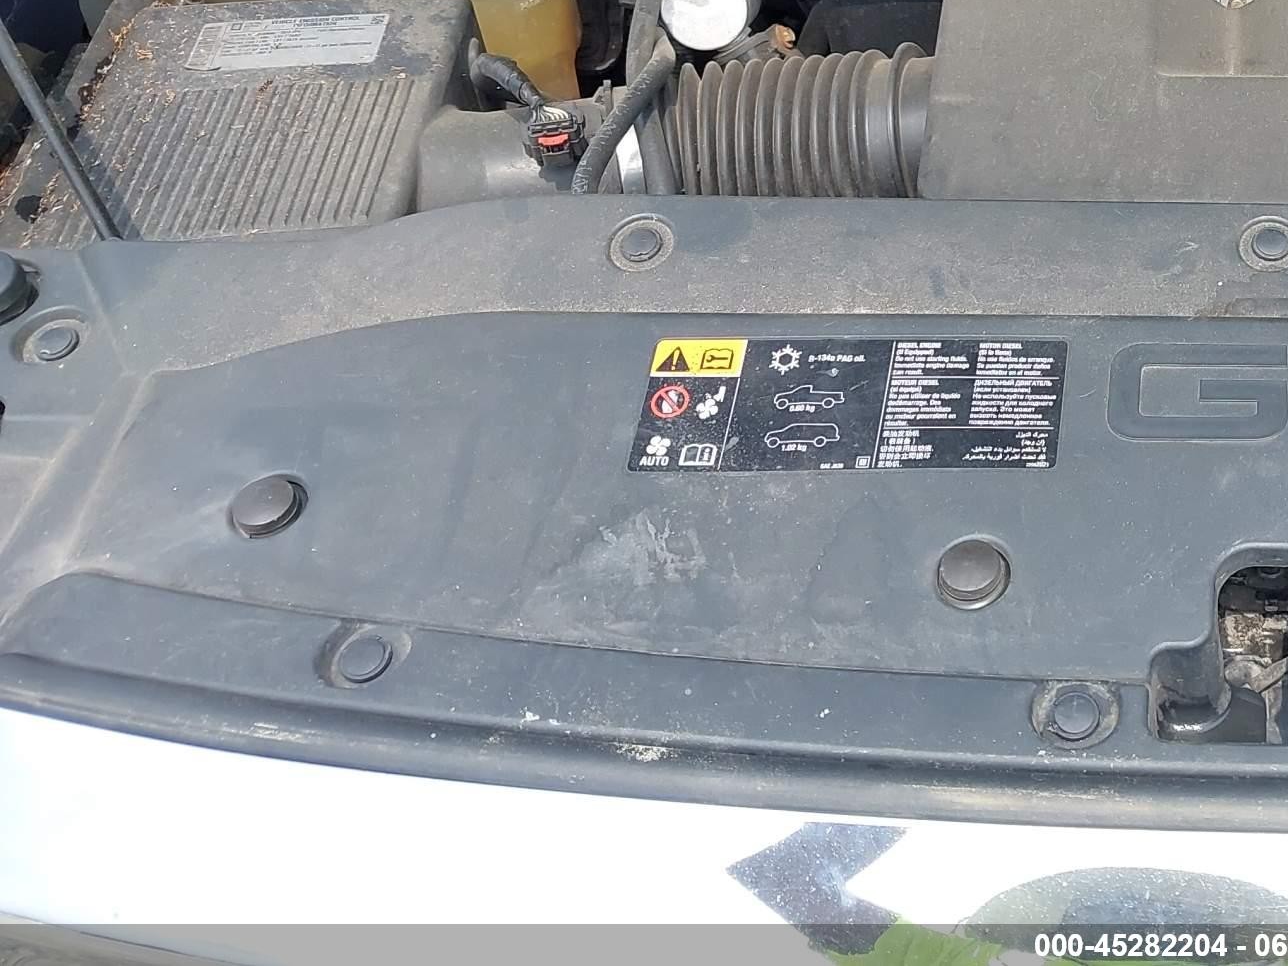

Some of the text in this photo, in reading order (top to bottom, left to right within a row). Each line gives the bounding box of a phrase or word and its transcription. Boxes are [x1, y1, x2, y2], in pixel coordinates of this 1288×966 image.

[836, 354, 854, 363] PAG
[797, 443, 808, 452] kg
[639, 456, 669, 466] AUTO
